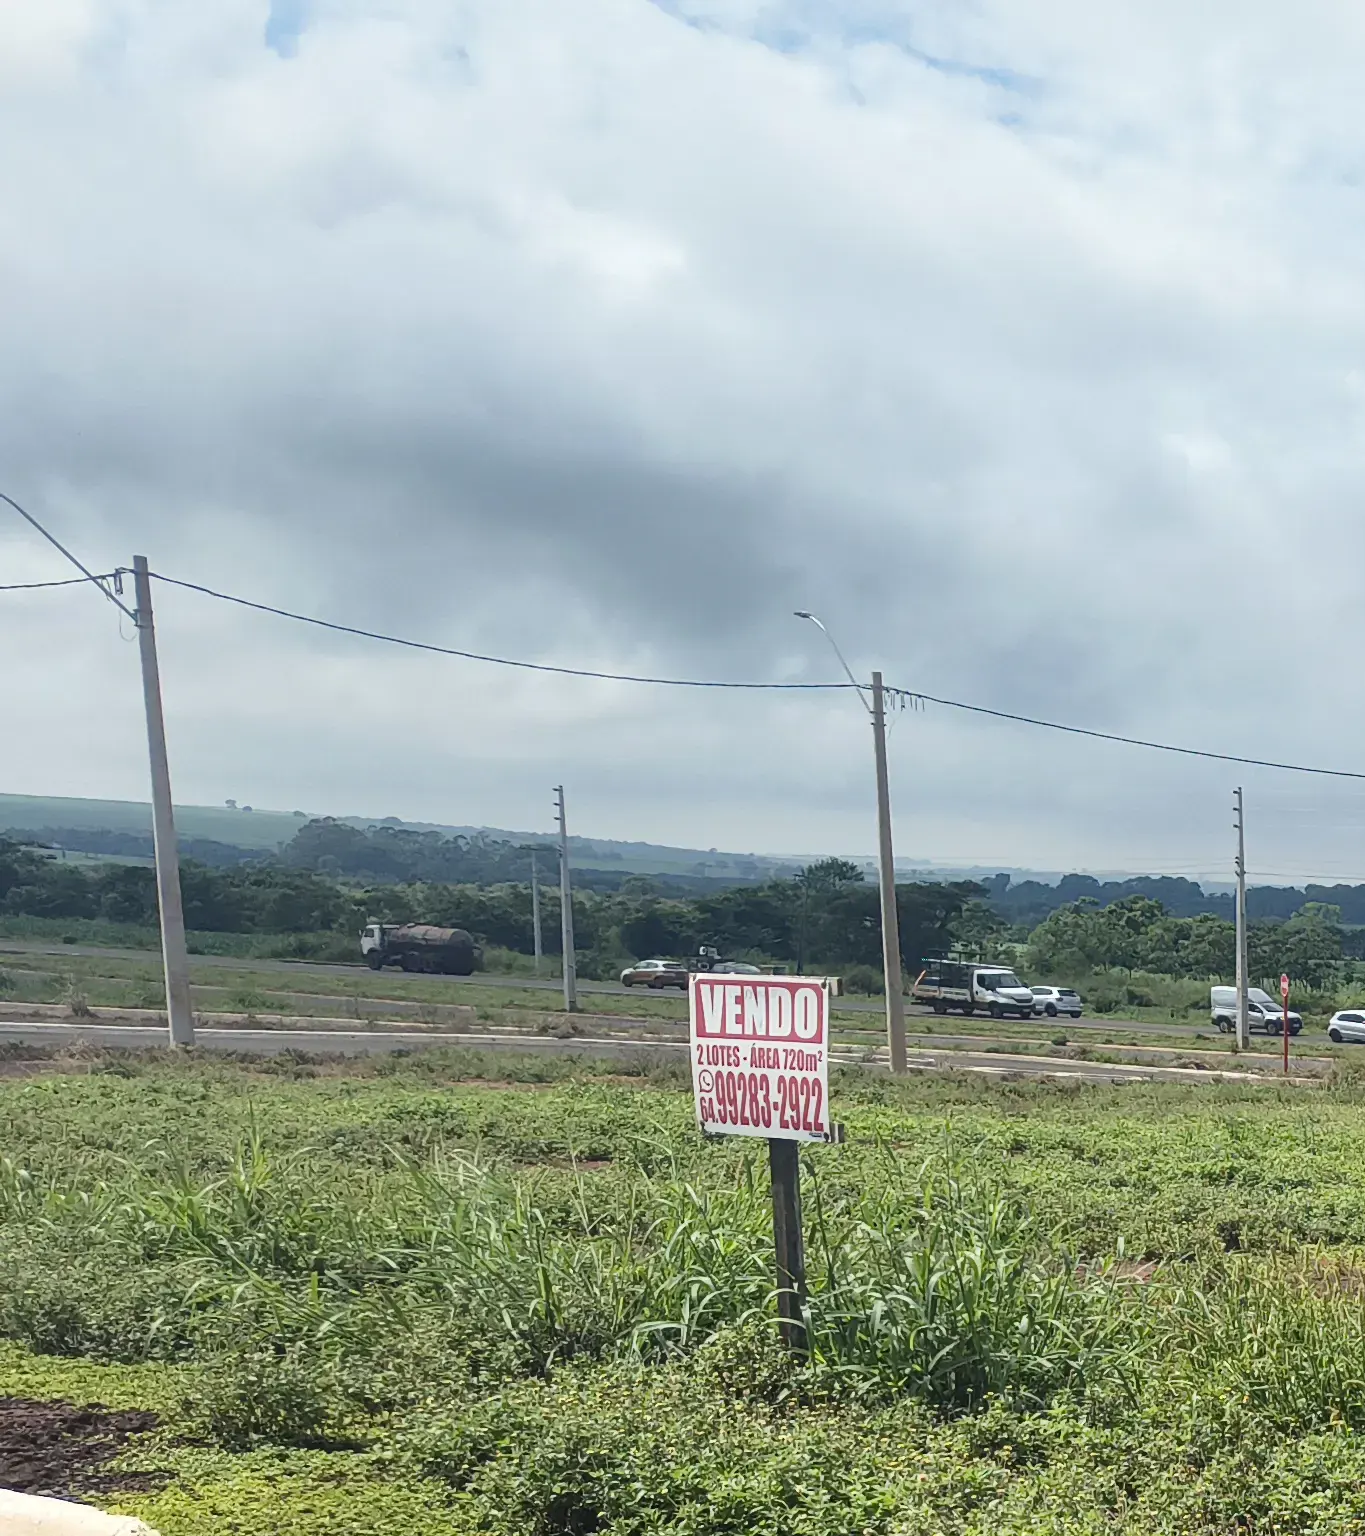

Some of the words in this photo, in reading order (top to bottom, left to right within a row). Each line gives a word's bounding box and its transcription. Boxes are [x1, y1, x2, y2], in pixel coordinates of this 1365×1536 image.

[700, 984, 818, 1039] VENDO
[697, 1044, 704, 1065] 2
[706, 1044, 740, 1067] LOTES
[750, 1043, 780, 1069] ÁREA
